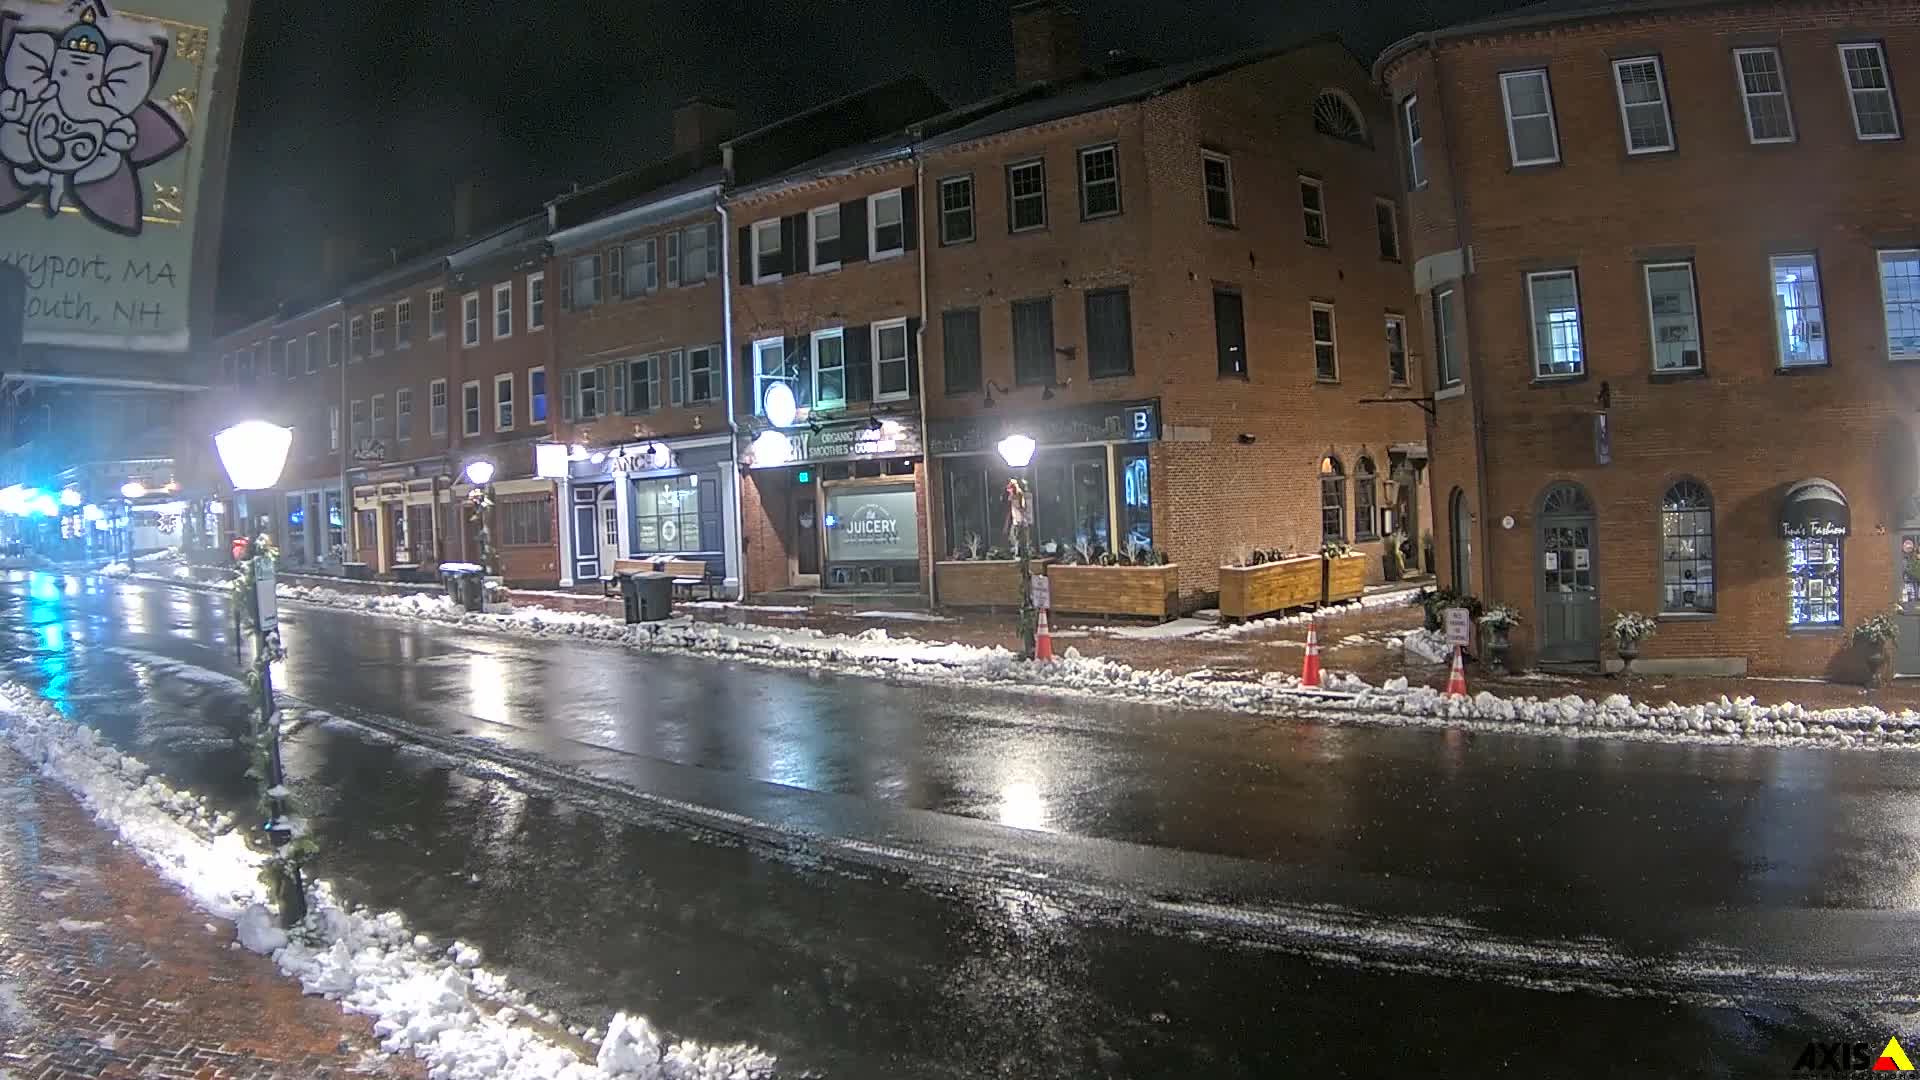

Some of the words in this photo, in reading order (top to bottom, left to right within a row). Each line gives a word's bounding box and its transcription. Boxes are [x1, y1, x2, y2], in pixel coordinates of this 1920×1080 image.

[0, 252, 112, 289] uryport,
[122, 259, 176, 288] MA
[25, 292, 99, 328] outh,
[113, 300, 164, 328] NH
[1134, 412, 1147, 431] B
[822, 431, 853, 443] ORGANIC
[808, 443, 849, 457] SMOOTHIES
[846, 519, 897, 534] JUICERY
[1809, 521, 1846, 536] Fashion
